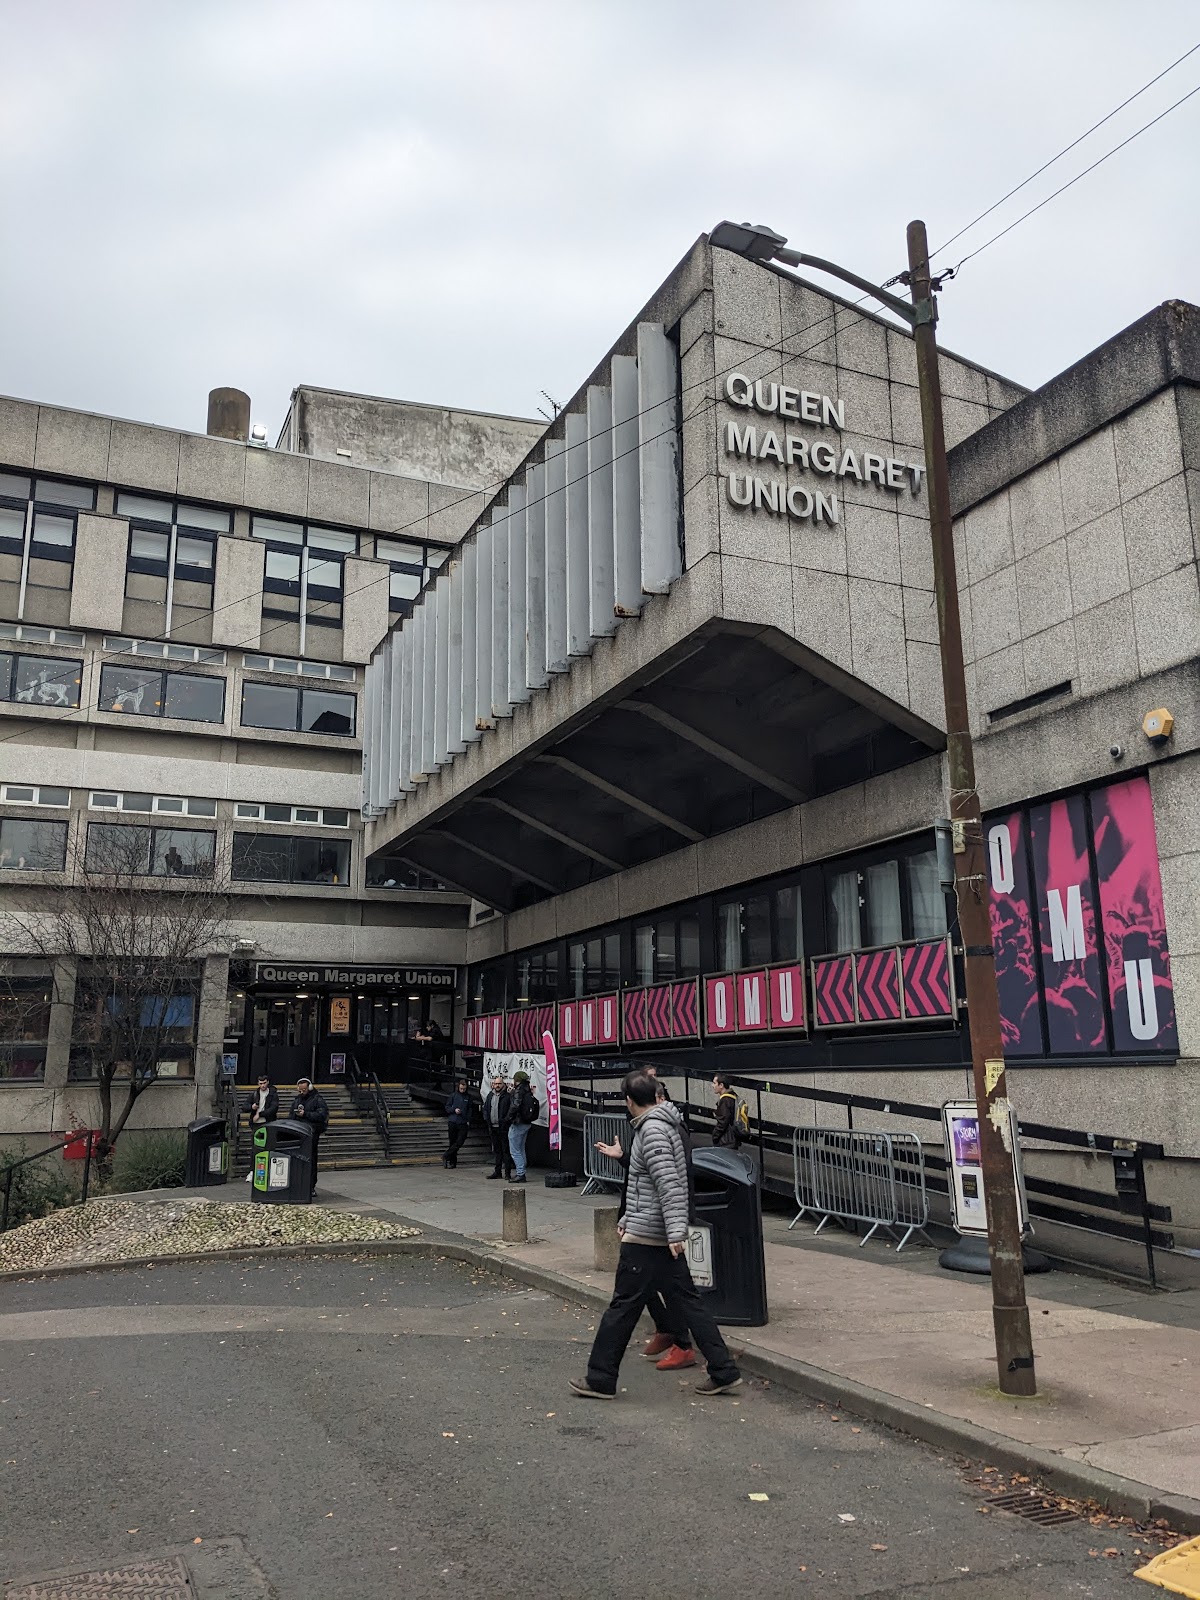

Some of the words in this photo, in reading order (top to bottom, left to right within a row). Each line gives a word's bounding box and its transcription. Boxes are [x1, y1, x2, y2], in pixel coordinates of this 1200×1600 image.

[725, 372, 845, 429] QUEEN
[725, 421, 926, 496] MARGARET
[727, 471, 839, 525] UNION
[263, 966, 319, 983] Queen
[324, 969, 401, 986] Margaret
[405, 971, 451, 985] Union
